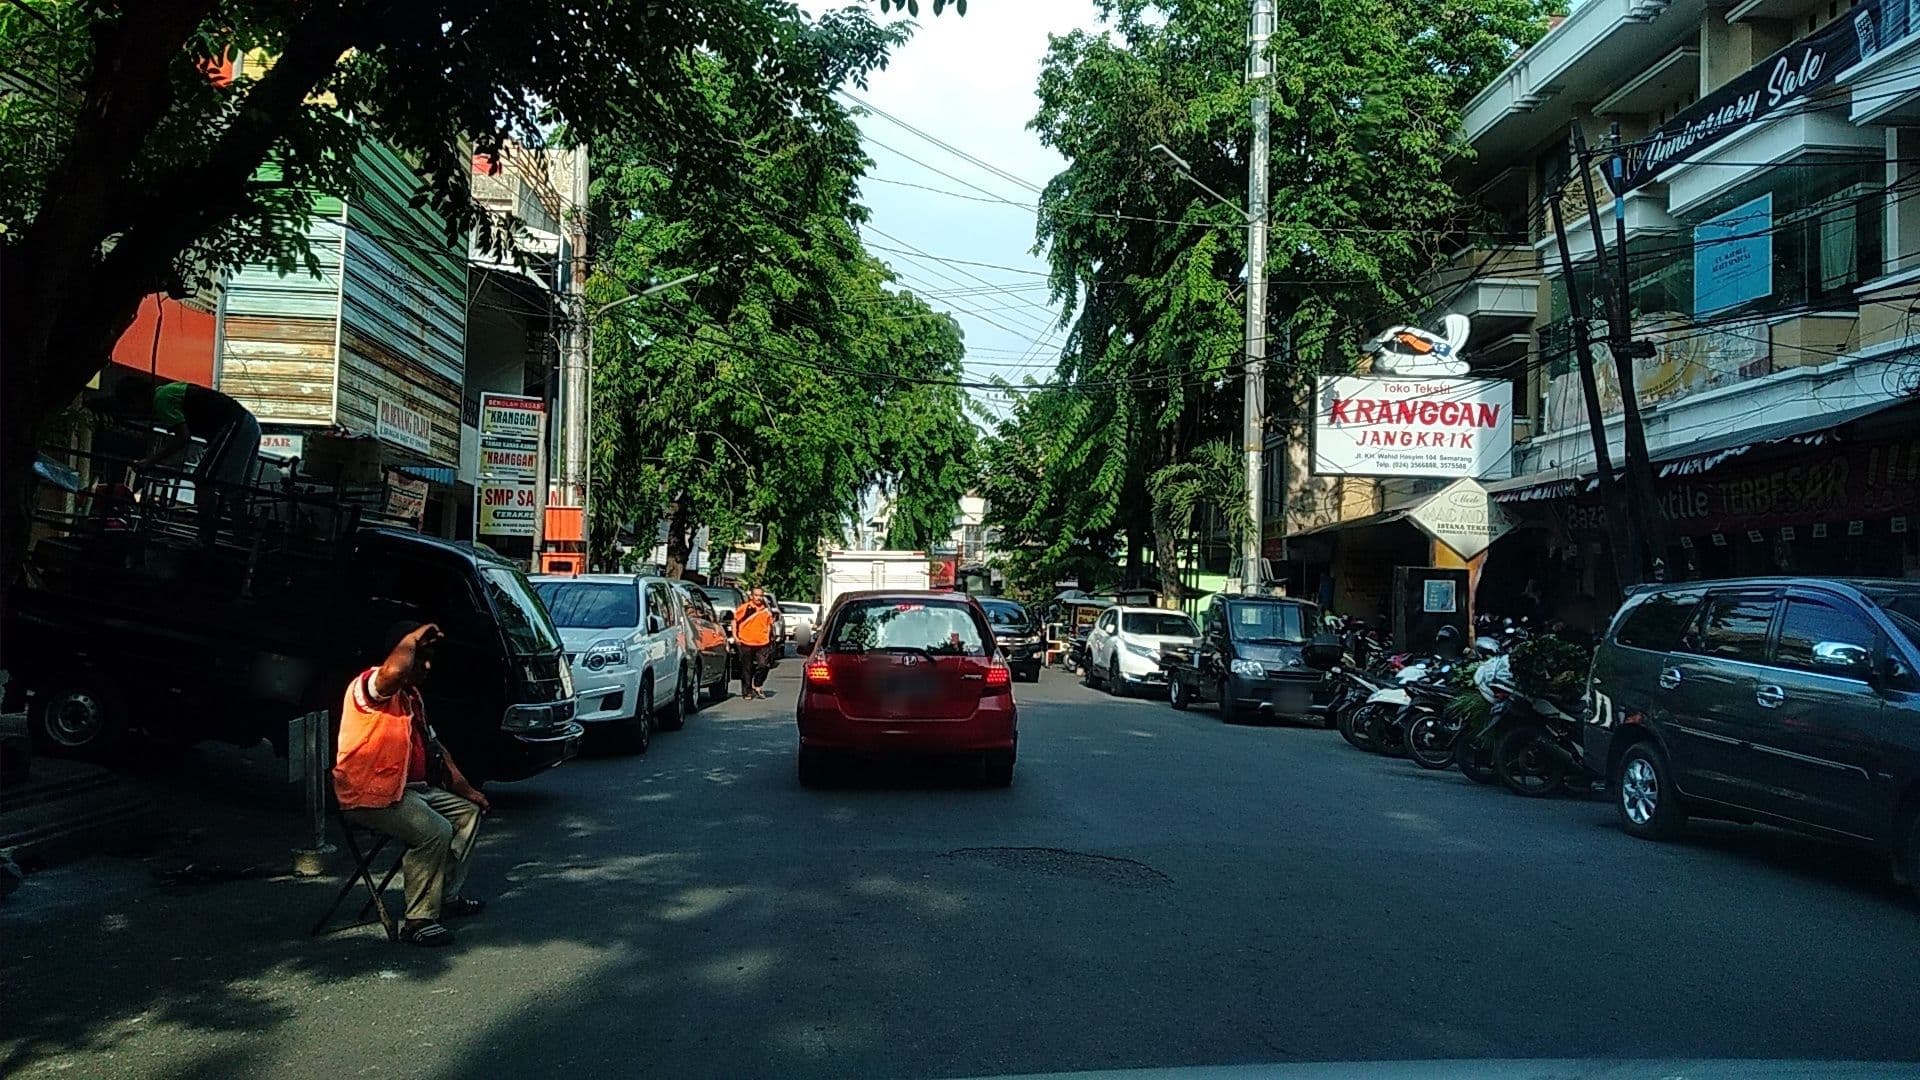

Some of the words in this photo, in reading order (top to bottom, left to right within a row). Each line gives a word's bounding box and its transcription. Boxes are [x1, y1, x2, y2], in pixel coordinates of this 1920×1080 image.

[1645, 90, 1761, 171] Anniversary
[1768, 48, 1827, 106] Sale
[1383, 383, 1410, 393] Toko
[1414, 383, 1450, 395] Tekstil
[1329, 398, 1501, 429] KRANGGAN
[263, 437, 290, 447] JAR
[1355, 431, 1475, 449] JANGKRIK
[1399, 453, 1424, 461] Hasyim
[1439, 454, 1473, 463] Semarang
[485, 488, 514, 506] SMP
[517, 489, 534, 507] SA
[1567, 501, 1608, 530] Baza
[1718, 455, 1852, 515] TERBESAR
[1437, 523, 1465, 531] ISTANA
[1466, 524, 1497, 532] TEKSTIL
